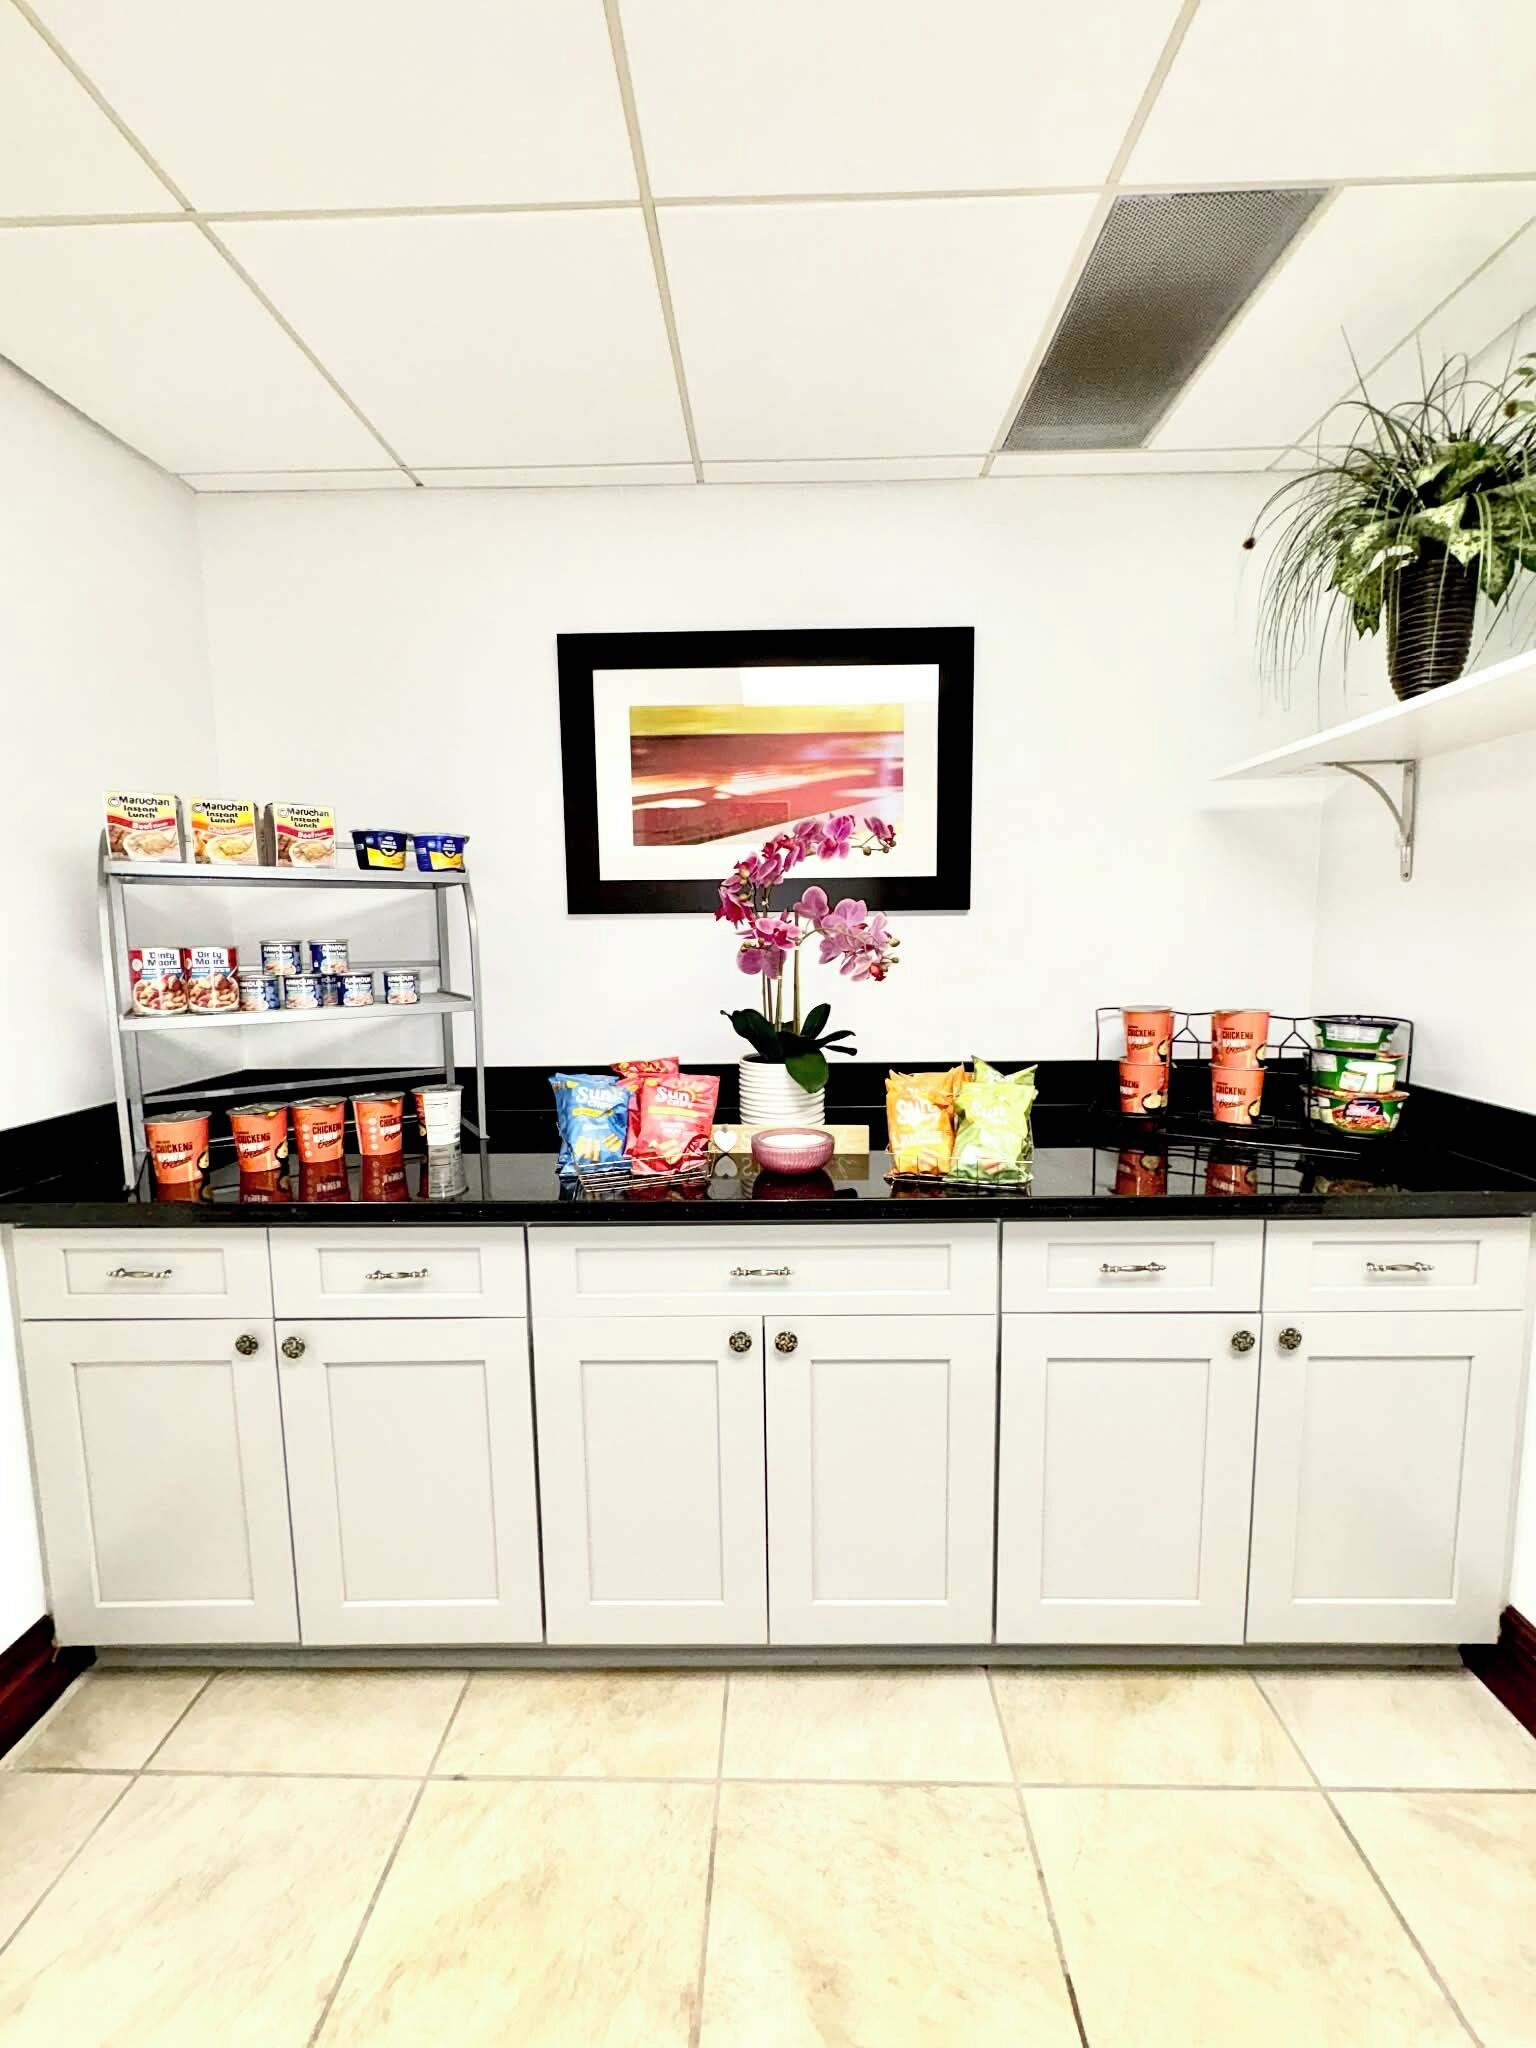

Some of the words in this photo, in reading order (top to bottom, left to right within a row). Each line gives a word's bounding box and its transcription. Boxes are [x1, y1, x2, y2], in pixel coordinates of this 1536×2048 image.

[118, 796, 170, 806] Maruchan
[123, 805, 159, 813] Instant
[202, 802, 249, 812] Maruchan
[128, 811, 156, 819] Lunch
[287, 808, 330, 817] Maruchan
[656, 1087, 689, 1103] Sun
